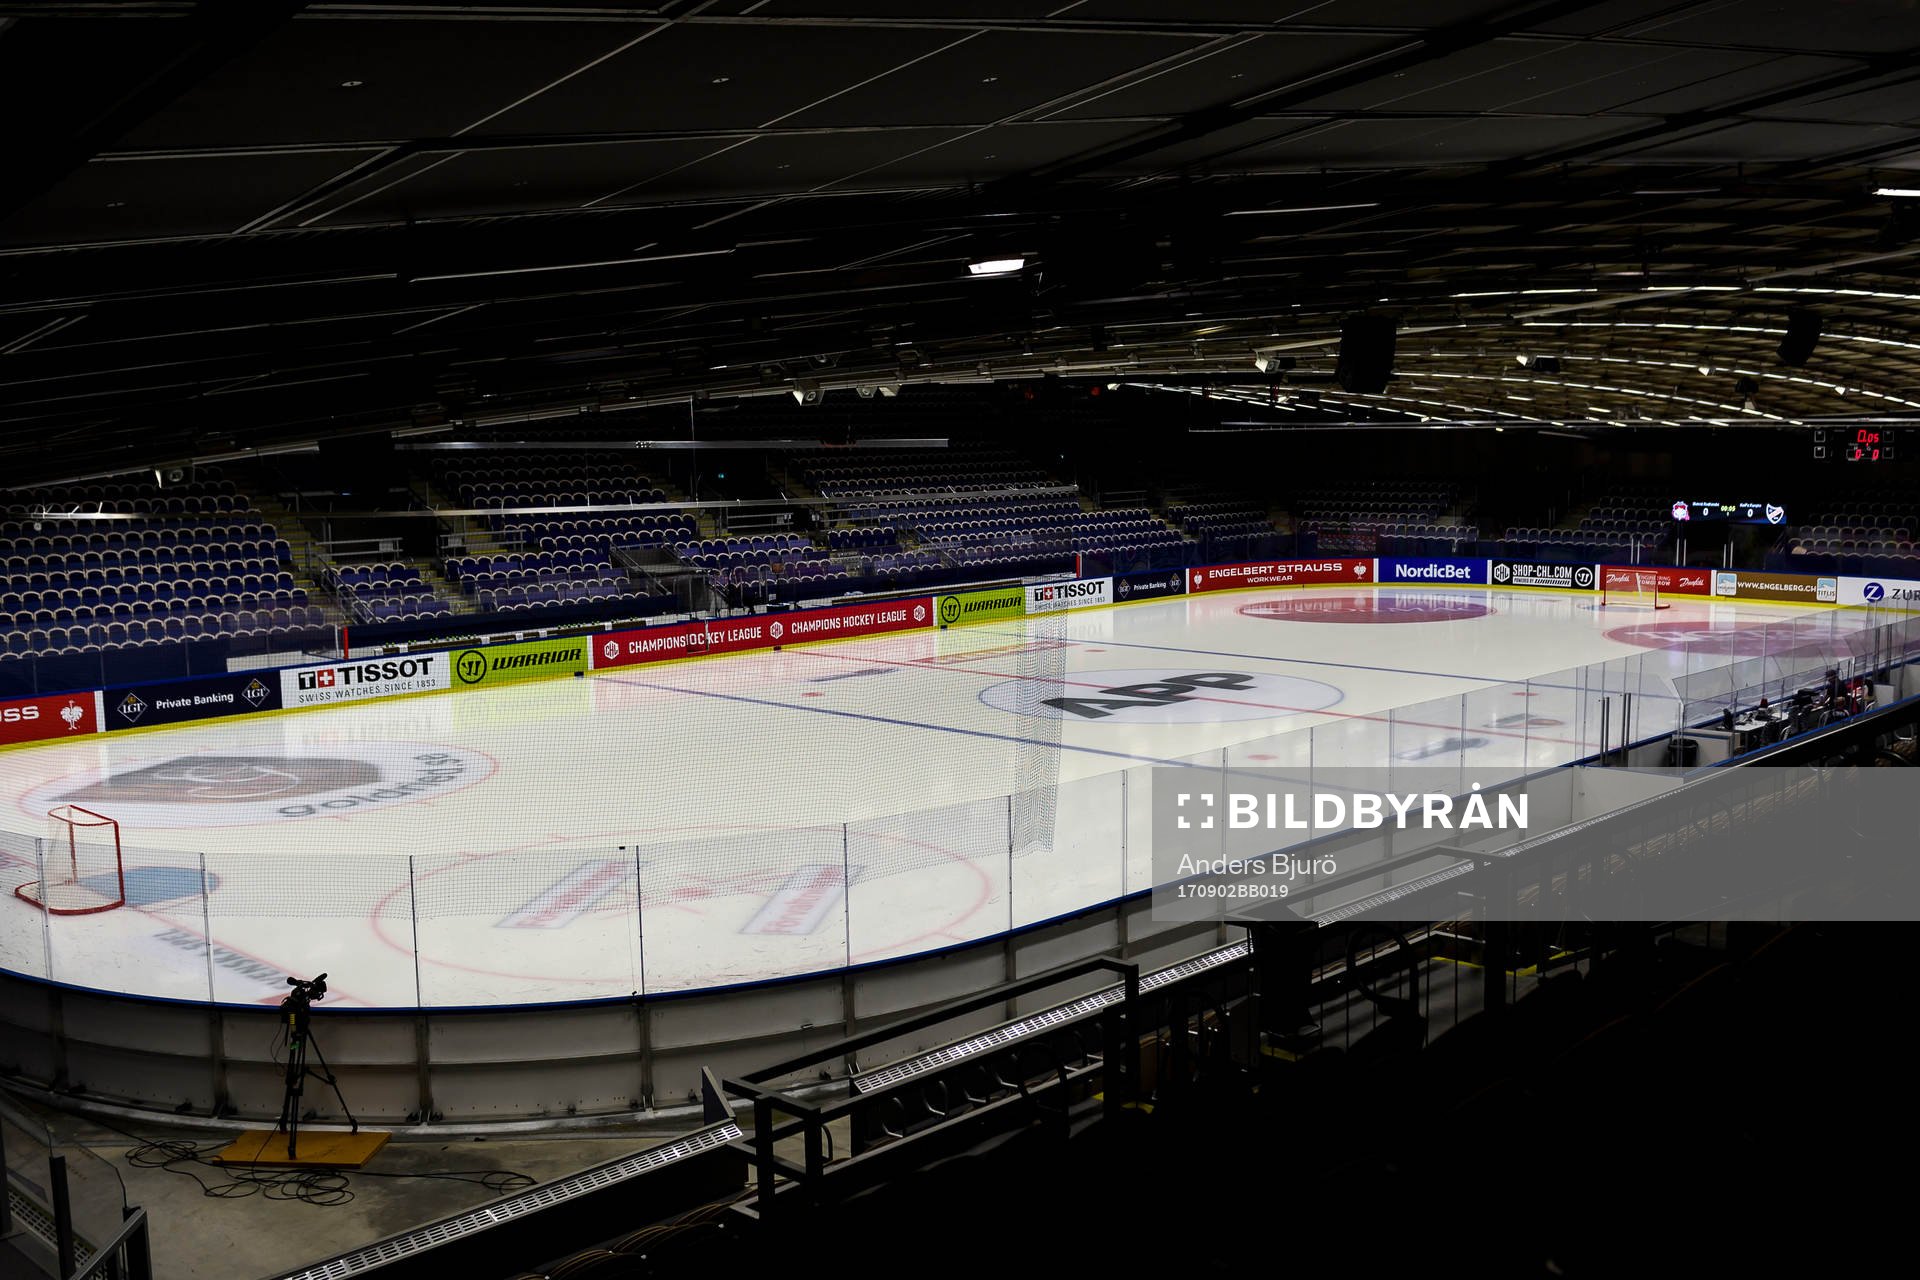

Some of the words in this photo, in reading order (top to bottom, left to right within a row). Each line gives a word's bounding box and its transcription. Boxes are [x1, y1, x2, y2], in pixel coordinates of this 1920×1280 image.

[1702, 507, 1709, 516] 0
[1747, 508, 1753, 518] 0
[1209, 565, 1274, 579] ENGELBERT
[1277, 562, 1343, 573] STRAUSS
[1247, 575, 1293, 583] WORKWEAR
[1395, 563, 1471, 579] NordicBet
[1512, 564, 1572, 579] SHOP-CHL.COM
[1054, 581, 1105, 599] TISSOT
[1133, 583, 1149, 591] Private
[1149, 580, 1166, 589] Banking
[1737, 581, 1817, 593] WWW.ENGELBERG.CH
[964, 596, 1022, 613] WARRIOR
[791, 617, 841, 634] CHAMPIONS
[843, 613, 875, 628] HOCKEY
[877, 609, 907, 624] LEAGUE
[628, 636, 686, 654] CHAMPIONS
[727, 626, 762, 642] LEAGUE
[492, 648, 582, 671] WARRIOR
[337, 657, 434, 685] TISSOT
[299, 691, 331, 704] SWISS
[334, 686, 381, 699] WATCHES
[384, 682, 412, 693] SINCE
[416, 679, 436, 688] 1853
[156, 697, 192, 710] Private
[193, 692, 234, 705] Banking
[0, 705, 40, 722] SS
